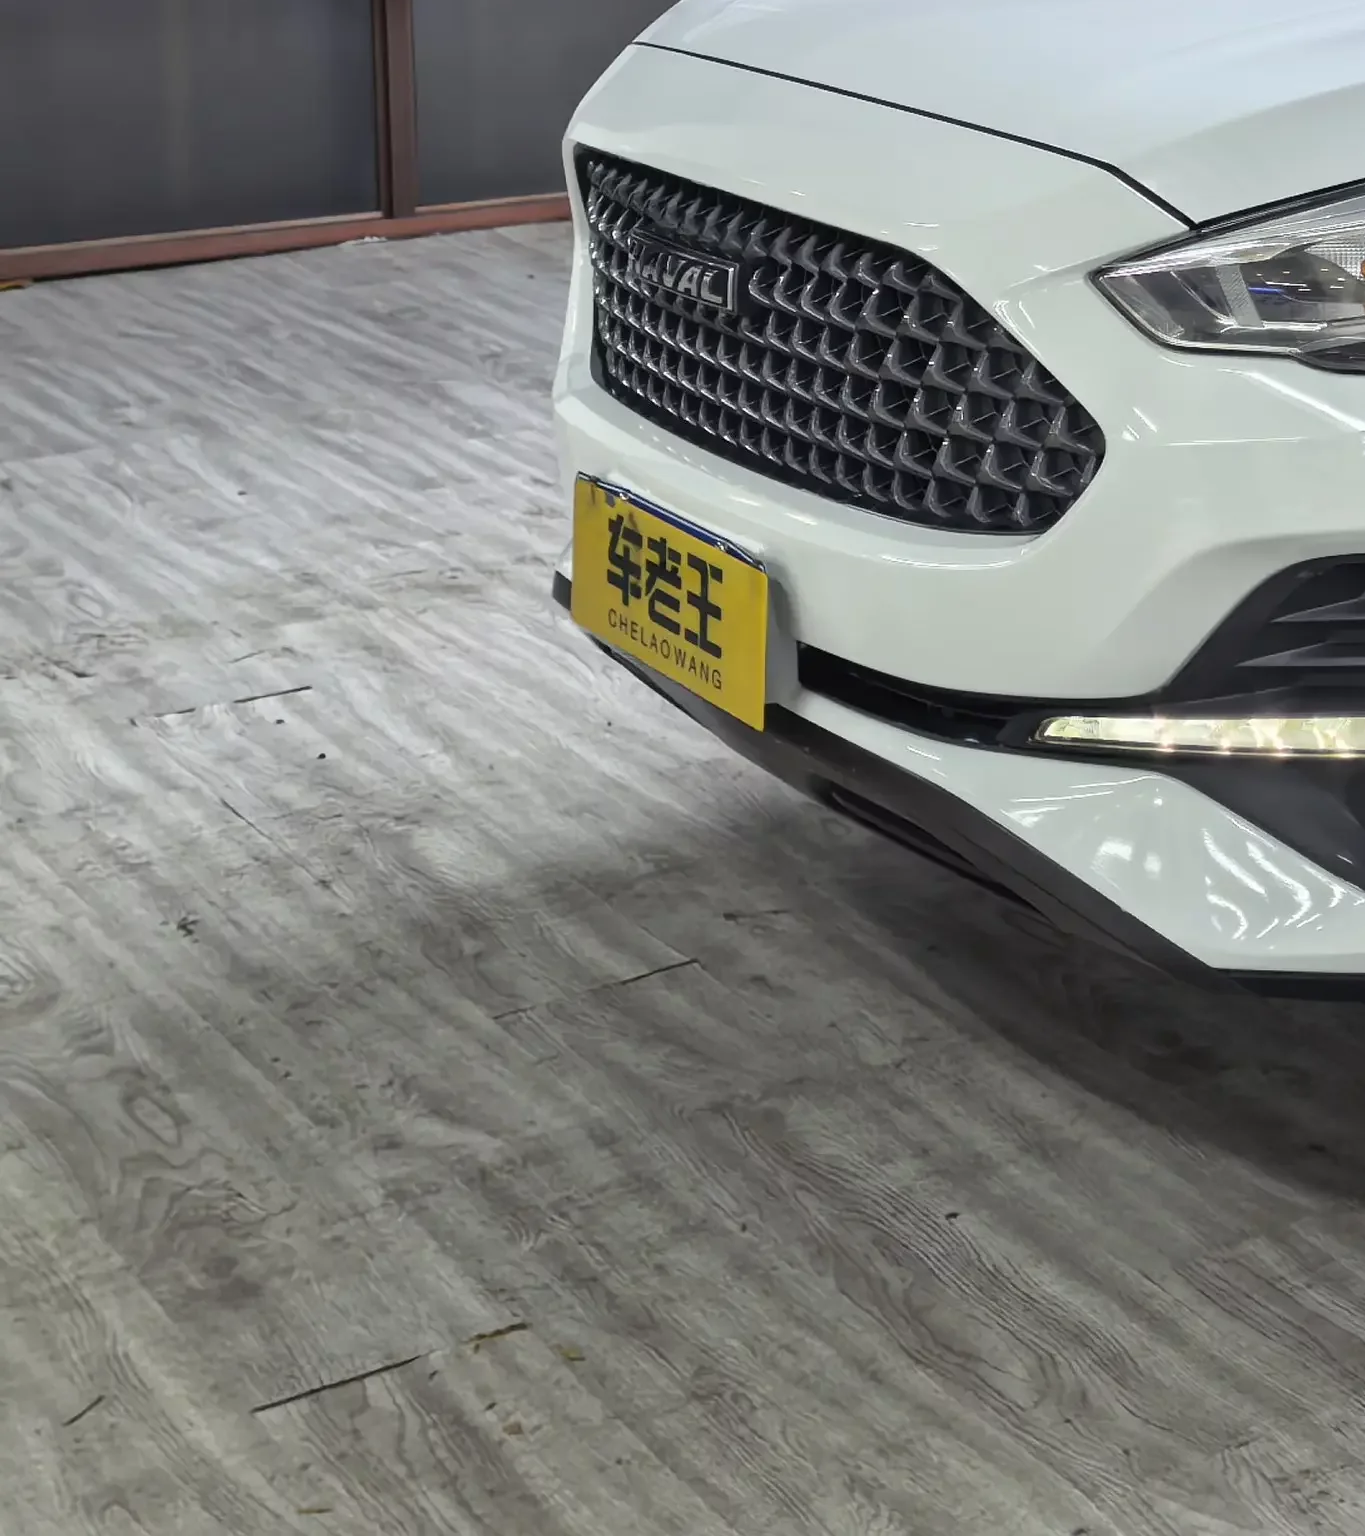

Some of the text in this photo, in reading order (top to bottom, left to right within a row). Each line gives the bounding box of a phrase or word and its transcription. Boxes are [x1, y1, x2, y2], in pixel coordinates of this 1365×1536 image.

[607, 514, 724, 659] 车老王
[608, 609, 723, 690] CHELAOWANG
